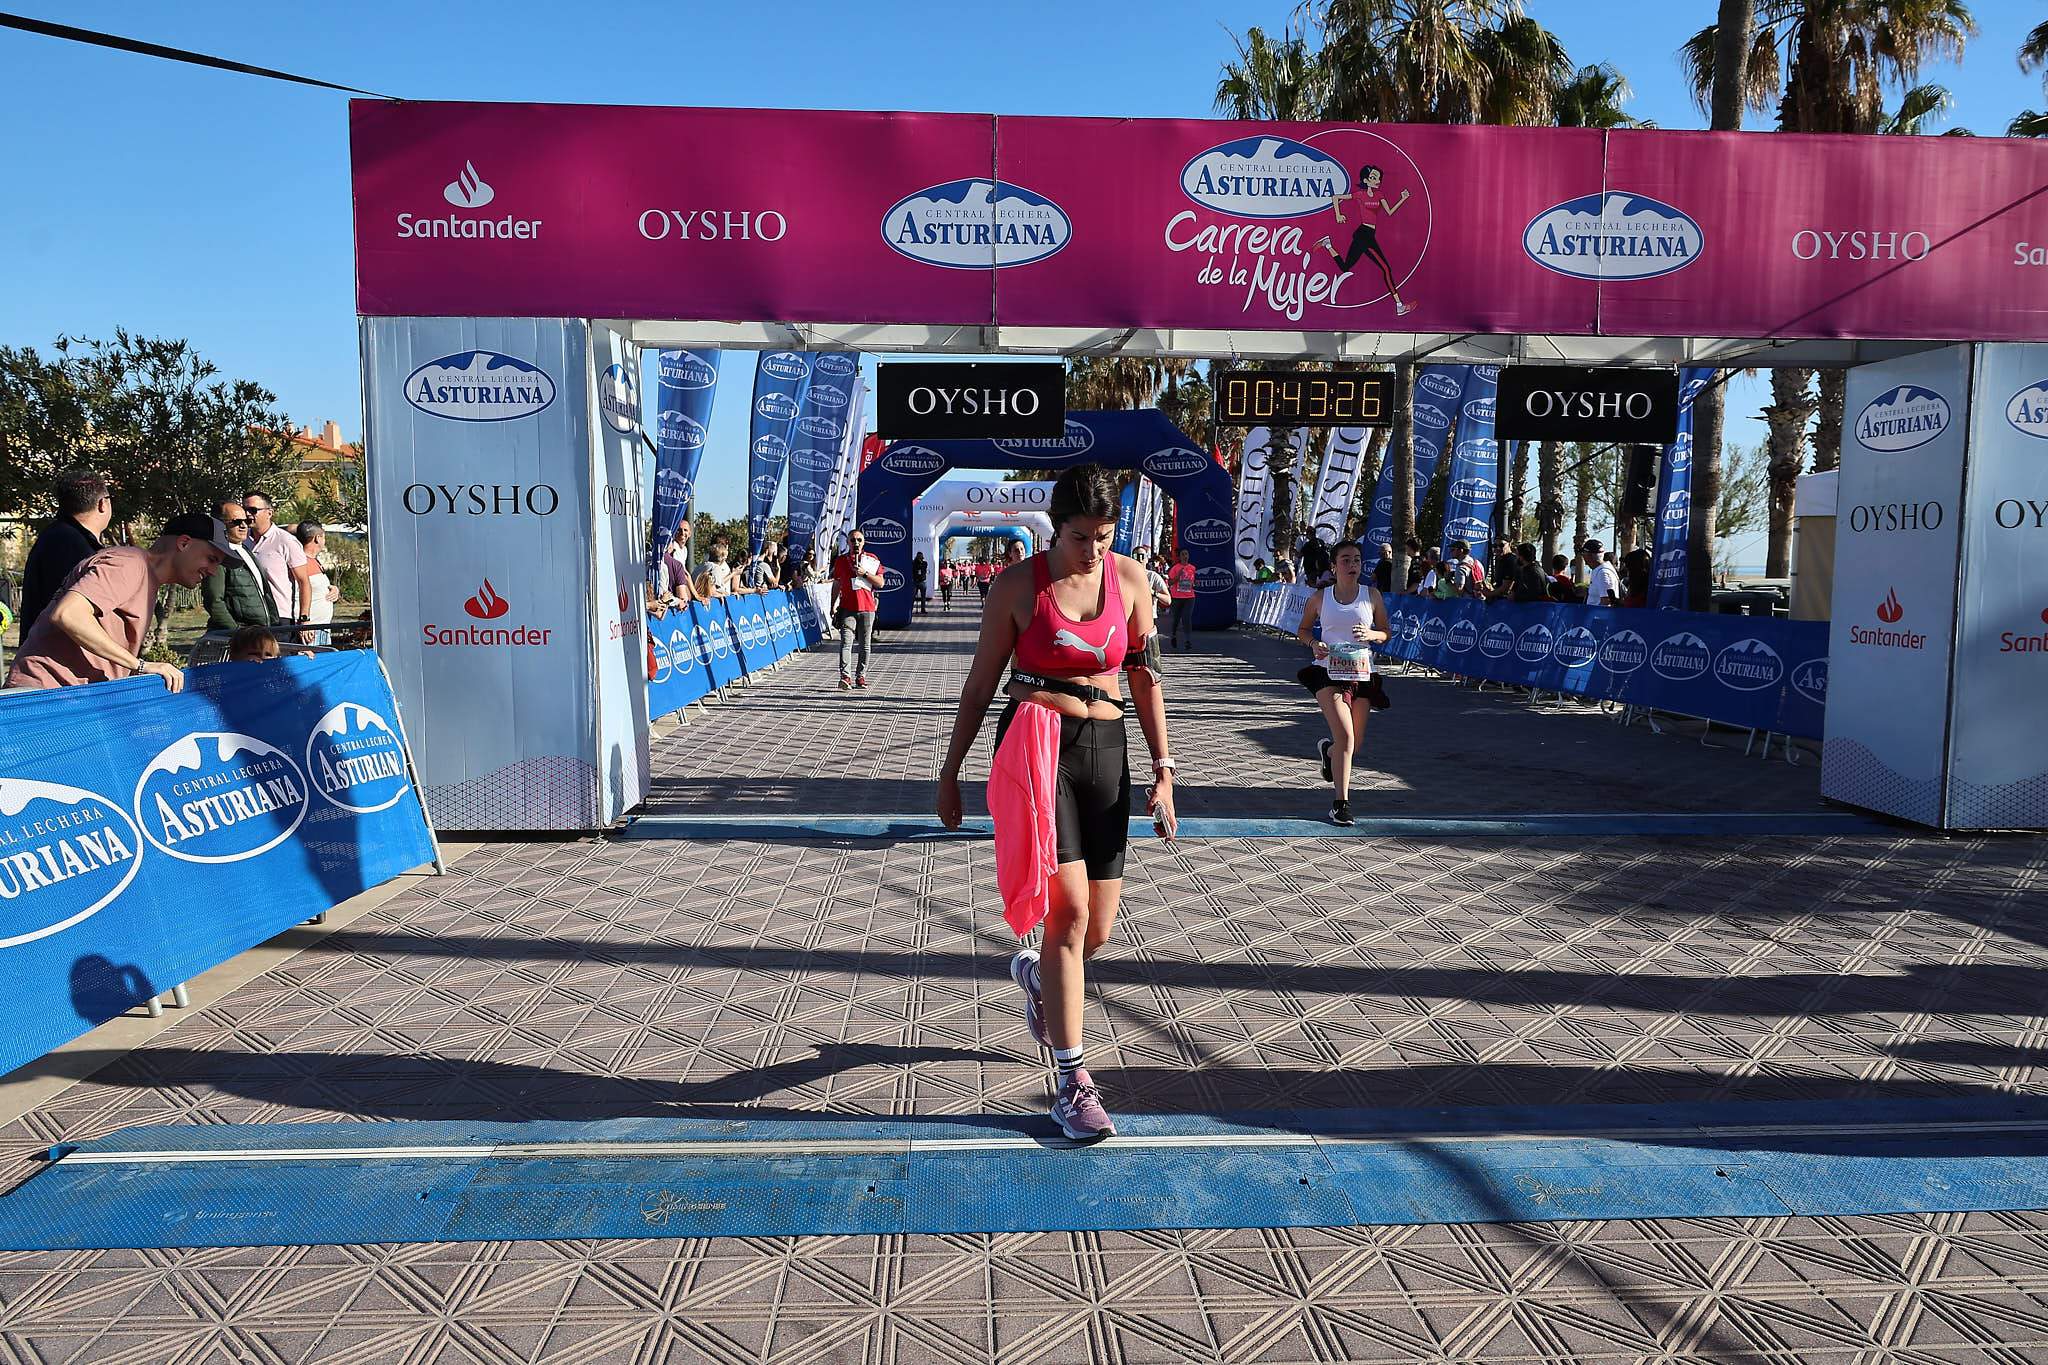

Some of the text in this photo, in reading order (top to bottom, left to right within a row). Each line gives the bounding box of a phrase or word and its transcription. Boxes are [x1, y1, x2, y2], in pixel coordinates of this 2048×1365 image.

[1193, 164, 1335, 198] ASTURIANA
[1221, 163, 1332, 174] CENTRAL LECHERA
[397, 213, 542, 240] Santander
[638, 209, 786, 241] OYSHO
[896, 211, 1057, 245] ASTURIANA
[926, 210, 985, 218] CENTRAL
[1566, 222, 1684, 232] CENTRAL LECHERA
[1165, 210, 1303, 255] Carrera
[1536, 223, 1689, 257] ASTURIANA
[1792, 230, 1931, 261] OYSHO
[2014, 242, 2048, 266] Sa
[1198, 250, 1354, 321] de la Mujer
[416, 376, 546, 404] ASTURIANA
[908, 387, 1040, 416] OYSHO
[1228, 380, 1380, 417] 00:43:26
[1414, 410, 1446, 426] STURIANA
[1526, 390, 1652, 419] OYSHO
[1860, 412, 1942, 440] ASTURIANA
[885, 457, 940, 468] ASTURIANA
[1149, 460, 1204, 470] ASTURIANA
[402, 484, 559, 516] OYSHO
[602, 484, 640, 518] OYSHO
[966, 487, 1046, 504] OYSHO
[1236, 448, 1268, 560] OYSHO
[1850, 501, 1944, 532] OYSHO
[862, 528, 902, 538] STURIANA
[423, 624, 552, 646] Santander
[1556, 640, 1593, 658] ASTURIANA
[1850, 625, 1926, 650] Santander
[1601, 645, 1642, 664] ASTURIANA
[1654, 648, 1704, 670] ASTURIANA
[1717, 656, 1774, 680] ASTURIANA
[1798, 668, 1826, 692] AS
[330, 740, 365, 755] CENTRAL
[173, 759, 283, 797] CENTRAL LECHERA
[319, 750, 402, 793] ASTURIAN
[22, 807, 104, 838] LECHERA
[154, 775, 302, 846] ASTURIANA
